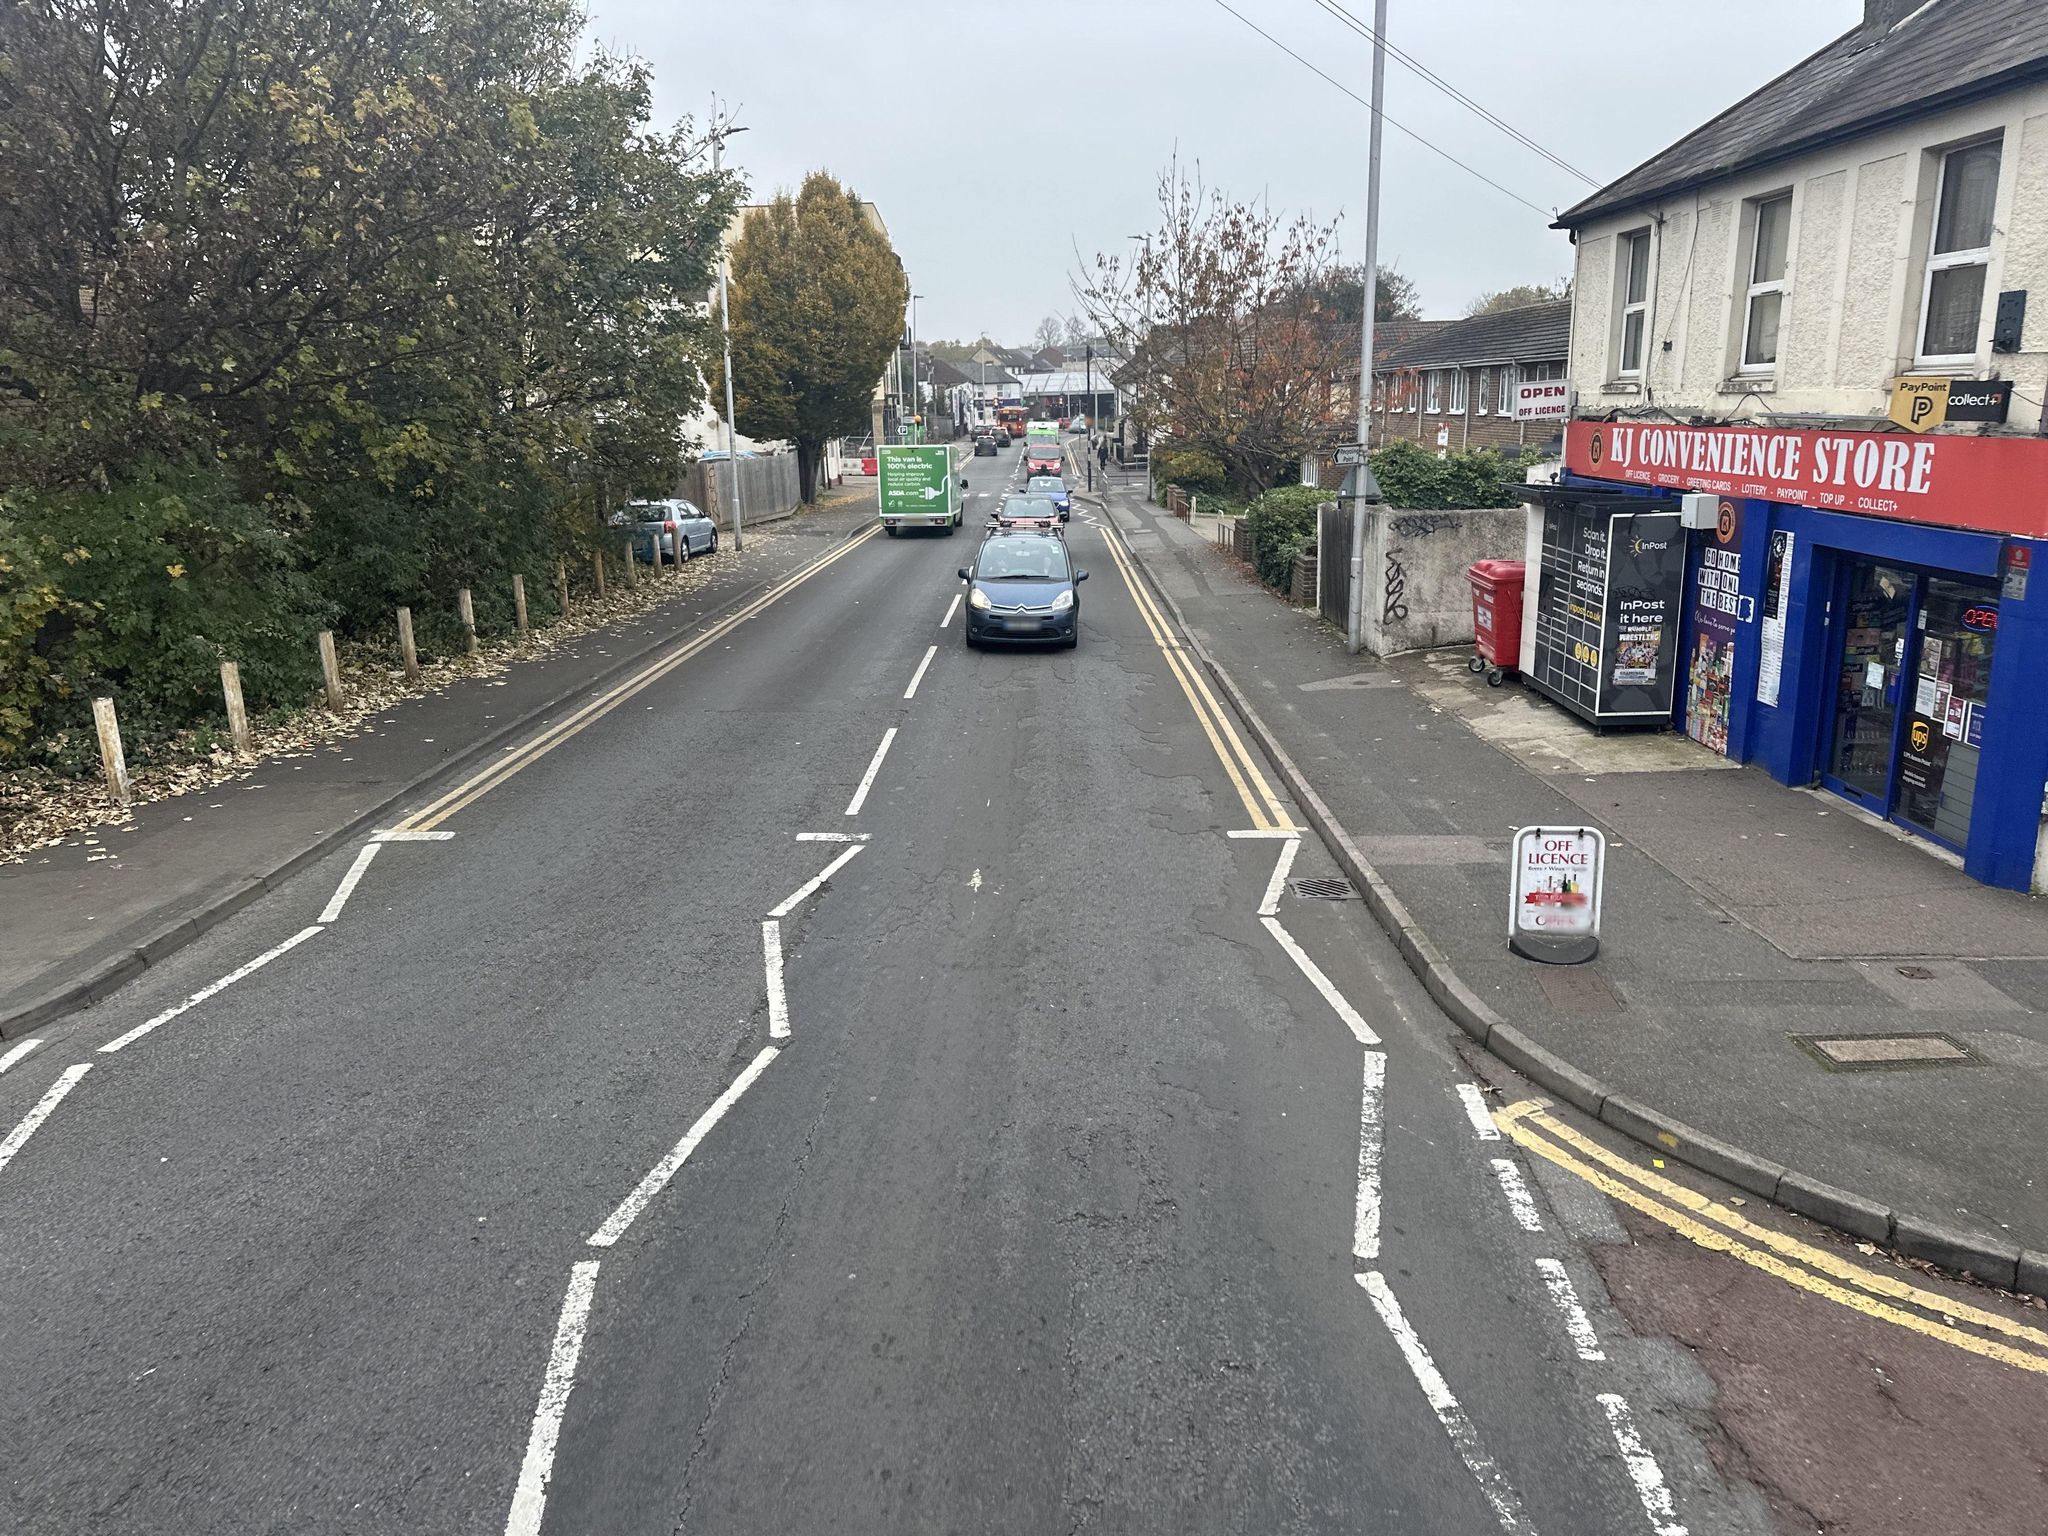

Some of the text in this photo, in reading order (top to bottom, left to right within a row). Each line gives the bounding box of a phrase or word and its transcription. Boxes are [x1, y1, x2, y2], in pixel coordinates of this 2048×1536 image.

[1520, 386, 1565, 399] OPEN
[1900, 382, 1947, 393] PayPoint
[1948, 393, 1998, 406] collect+
[1519, 405, 1566, 416] OFF LICENCE
[1610, 427, 1634, 467] KJ
[1639, 428, 1802, 481] CONVENIENCE
[1812, 437, 1935, 494] STORE
[1625, 469, 1898, 512] OFF LICENCE GROCERY GREETING CARDS LOTTERY PAYPOINT TOP UP COLLECT+
[1583, 527, 1599, 540] Scan
[1585, 544, 1600, 559] Drop
[1641, 541, 1667, 550] InPost
[1705, 548, 1716, 565] GO
[1577, 561, 1605, 579] Return in
[1699, 568, 1719, 587] WITH
[1576, 579, 1603, 596] seconds.
[1620, 599, 1665, 610] InPost
[1702, 590, 1716, 607] THE
[1620, 613, 1663, 623] it here
[1619, 633, 1659, 641] WRESTLING
[1913, 730, 1927, 746] ups
[1544, 840, 1573, 851] OFF
[1528, 853, 1589, 864] LICENCE
